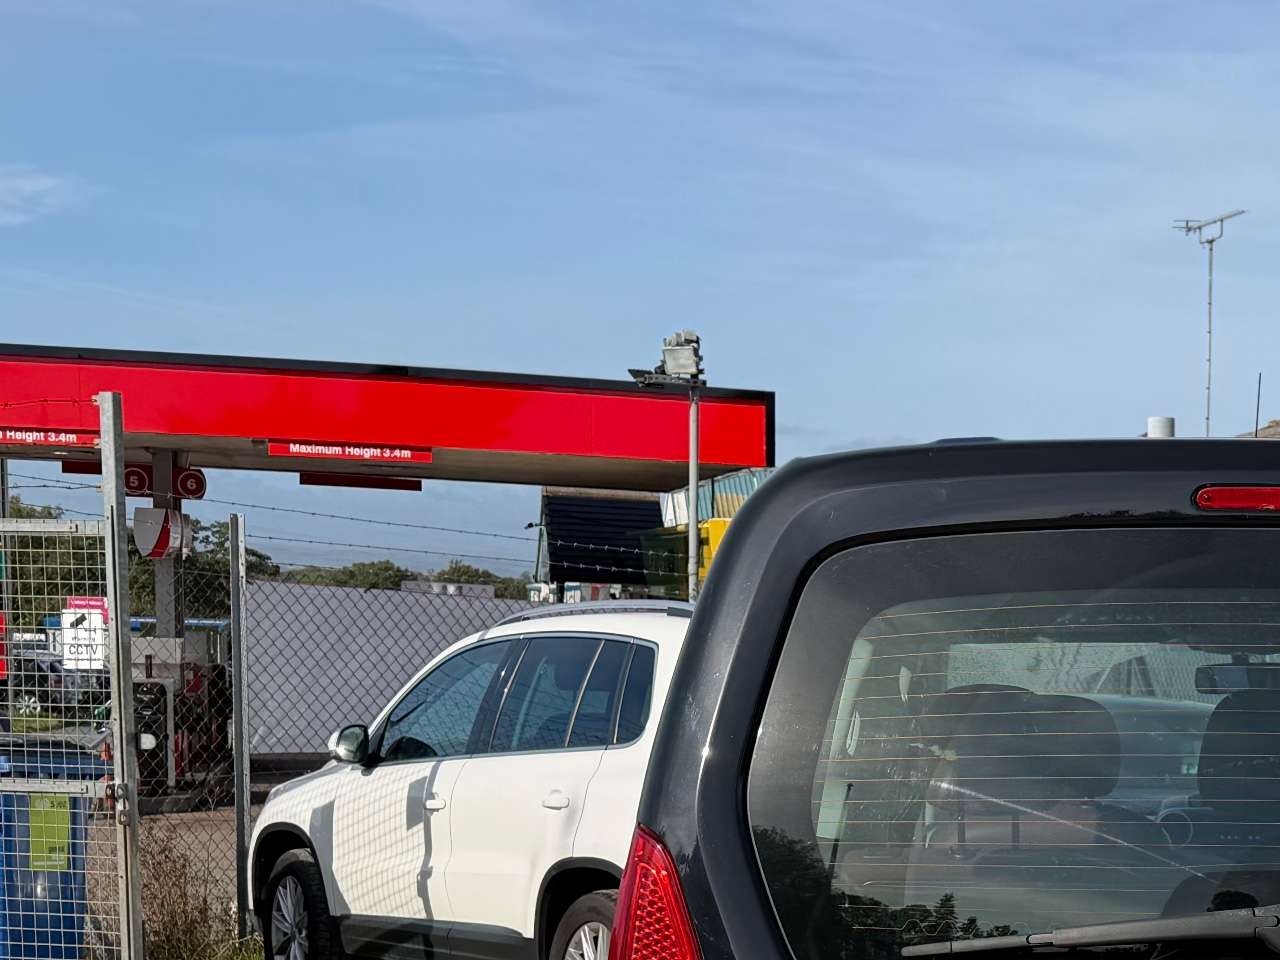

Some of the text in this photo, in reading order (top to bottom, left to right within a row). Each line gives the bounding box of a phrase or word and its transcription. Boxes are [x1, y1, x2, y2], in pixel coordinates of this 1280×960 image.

[6, 430, 44, 443] Height
[47, 432, 77, 443] 3.4m
[289, 443, 412, 459] Maximum Height 3.4m
[129, 476, 139, 488] 5
[187, 478, 197, 490] 6
[68, 644, 98, 655] CCTV
